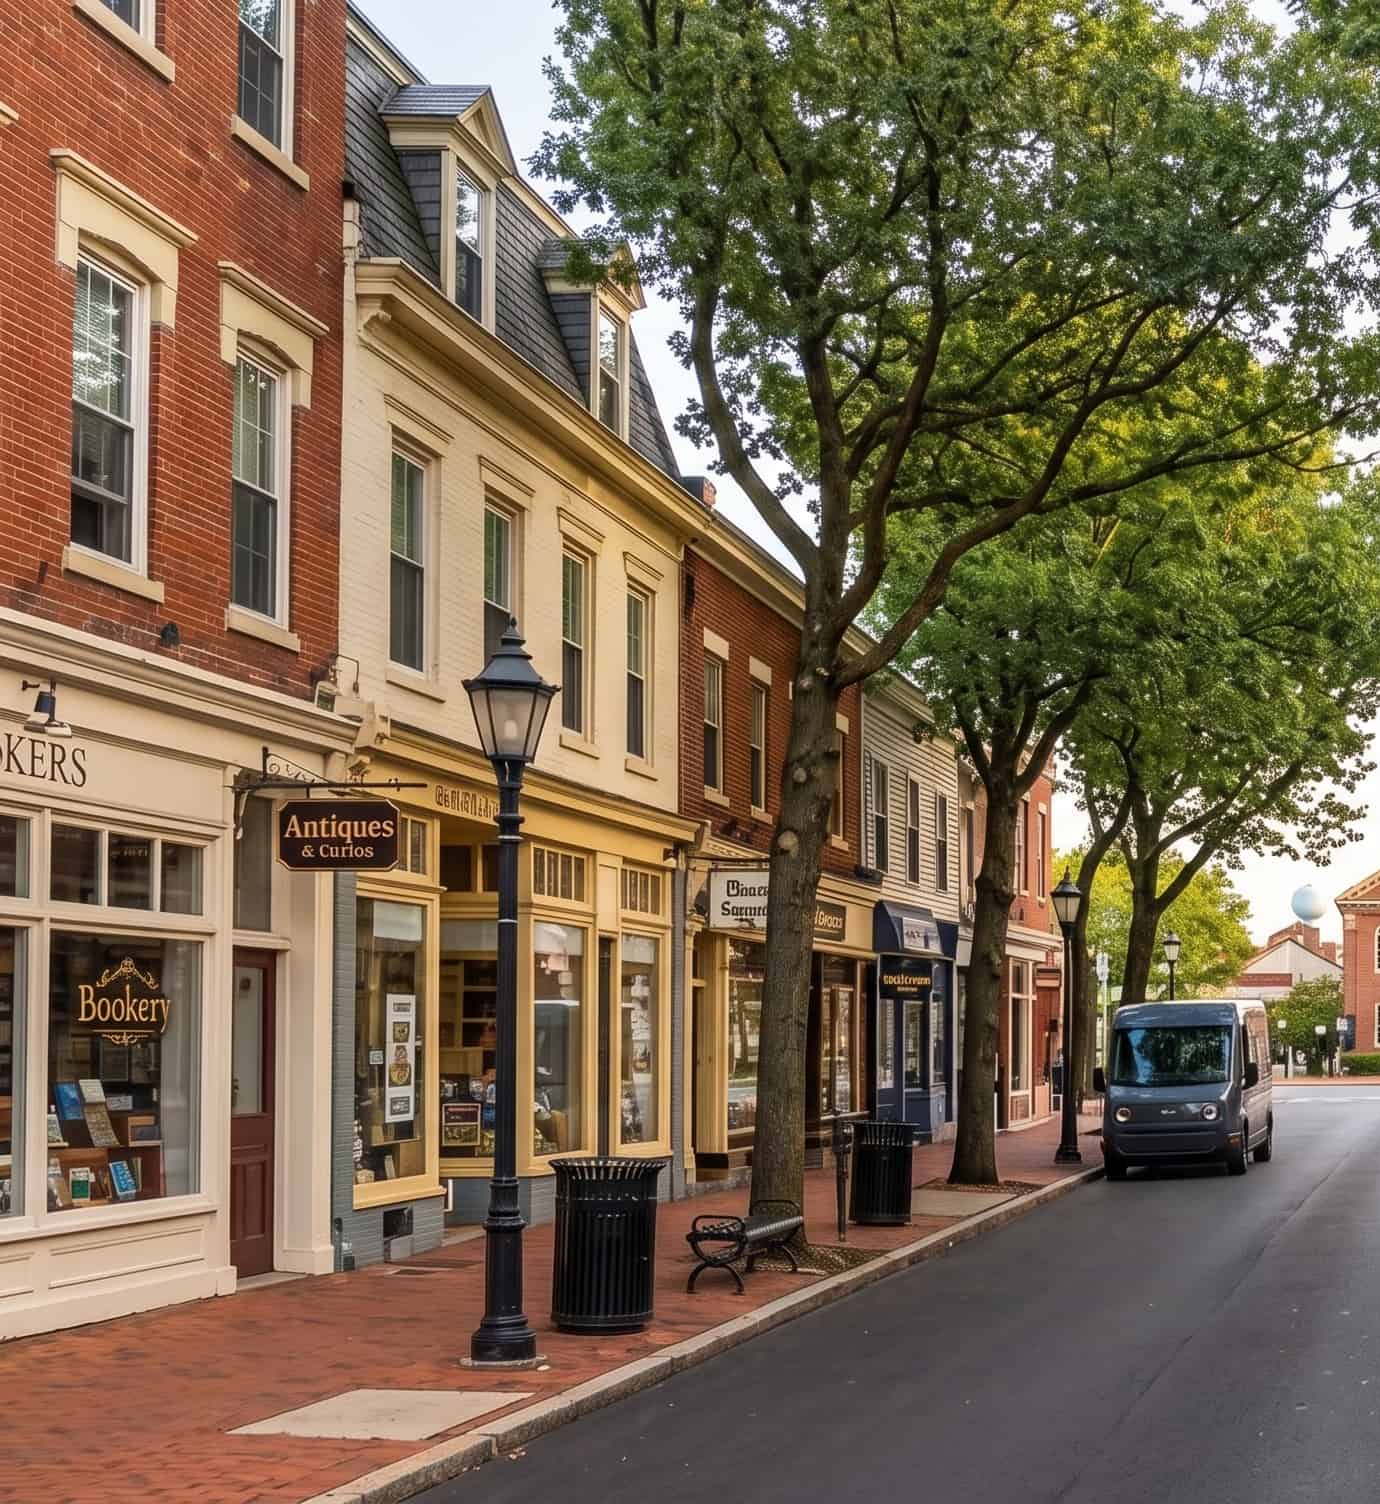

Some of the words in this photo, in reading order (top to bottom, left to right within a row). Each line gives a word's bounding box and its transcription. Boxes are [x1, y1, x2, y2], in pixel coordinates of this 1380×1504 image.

[0, 732, 87, 788] KERS
[283, 814, 395, 844] Antiques
[301, 844, 316, 858] &
[319, 843, 375, 858] Curios
[78, 984, 171, 1033] Bookery
